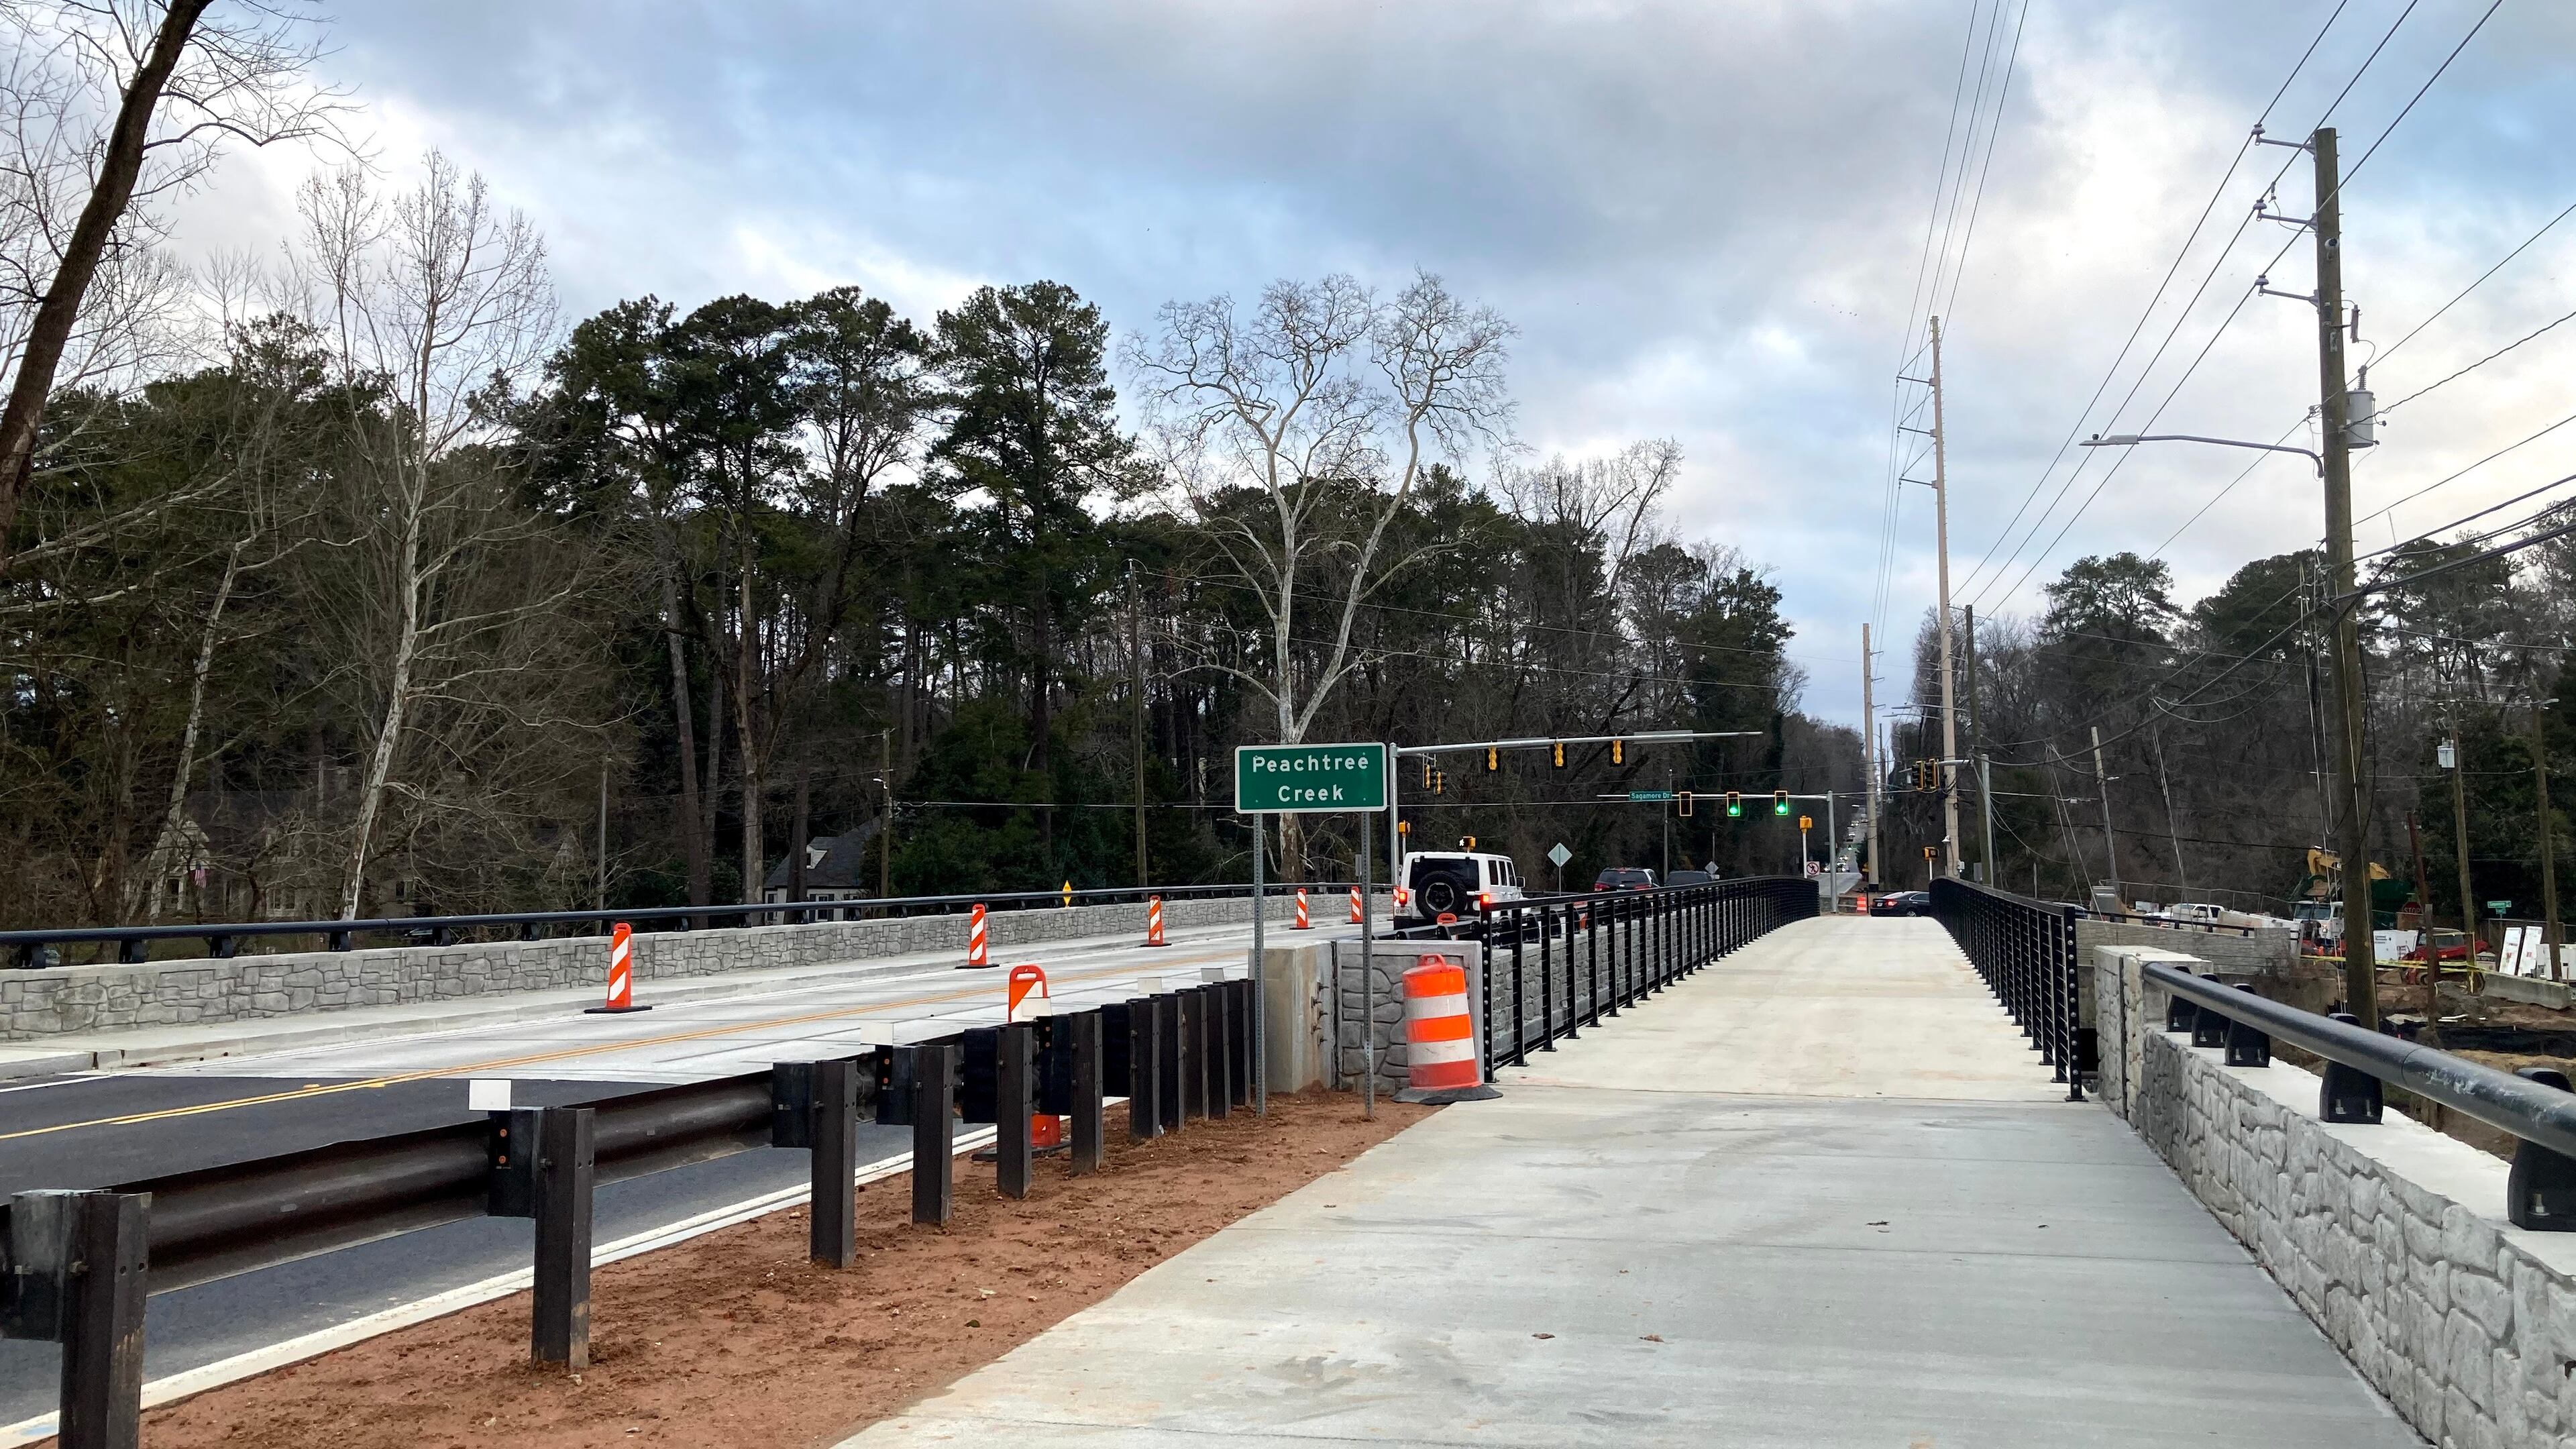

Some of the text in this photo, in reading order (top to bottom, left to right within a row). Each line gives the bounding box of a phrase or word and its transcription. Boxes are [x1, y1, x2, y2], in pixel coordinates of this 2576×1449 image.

[1252, 754, 1368, 773] Peachtree
[1278, 784, 1344, 802] Creek
[1631, 792, 1661, 800] Sagamore
